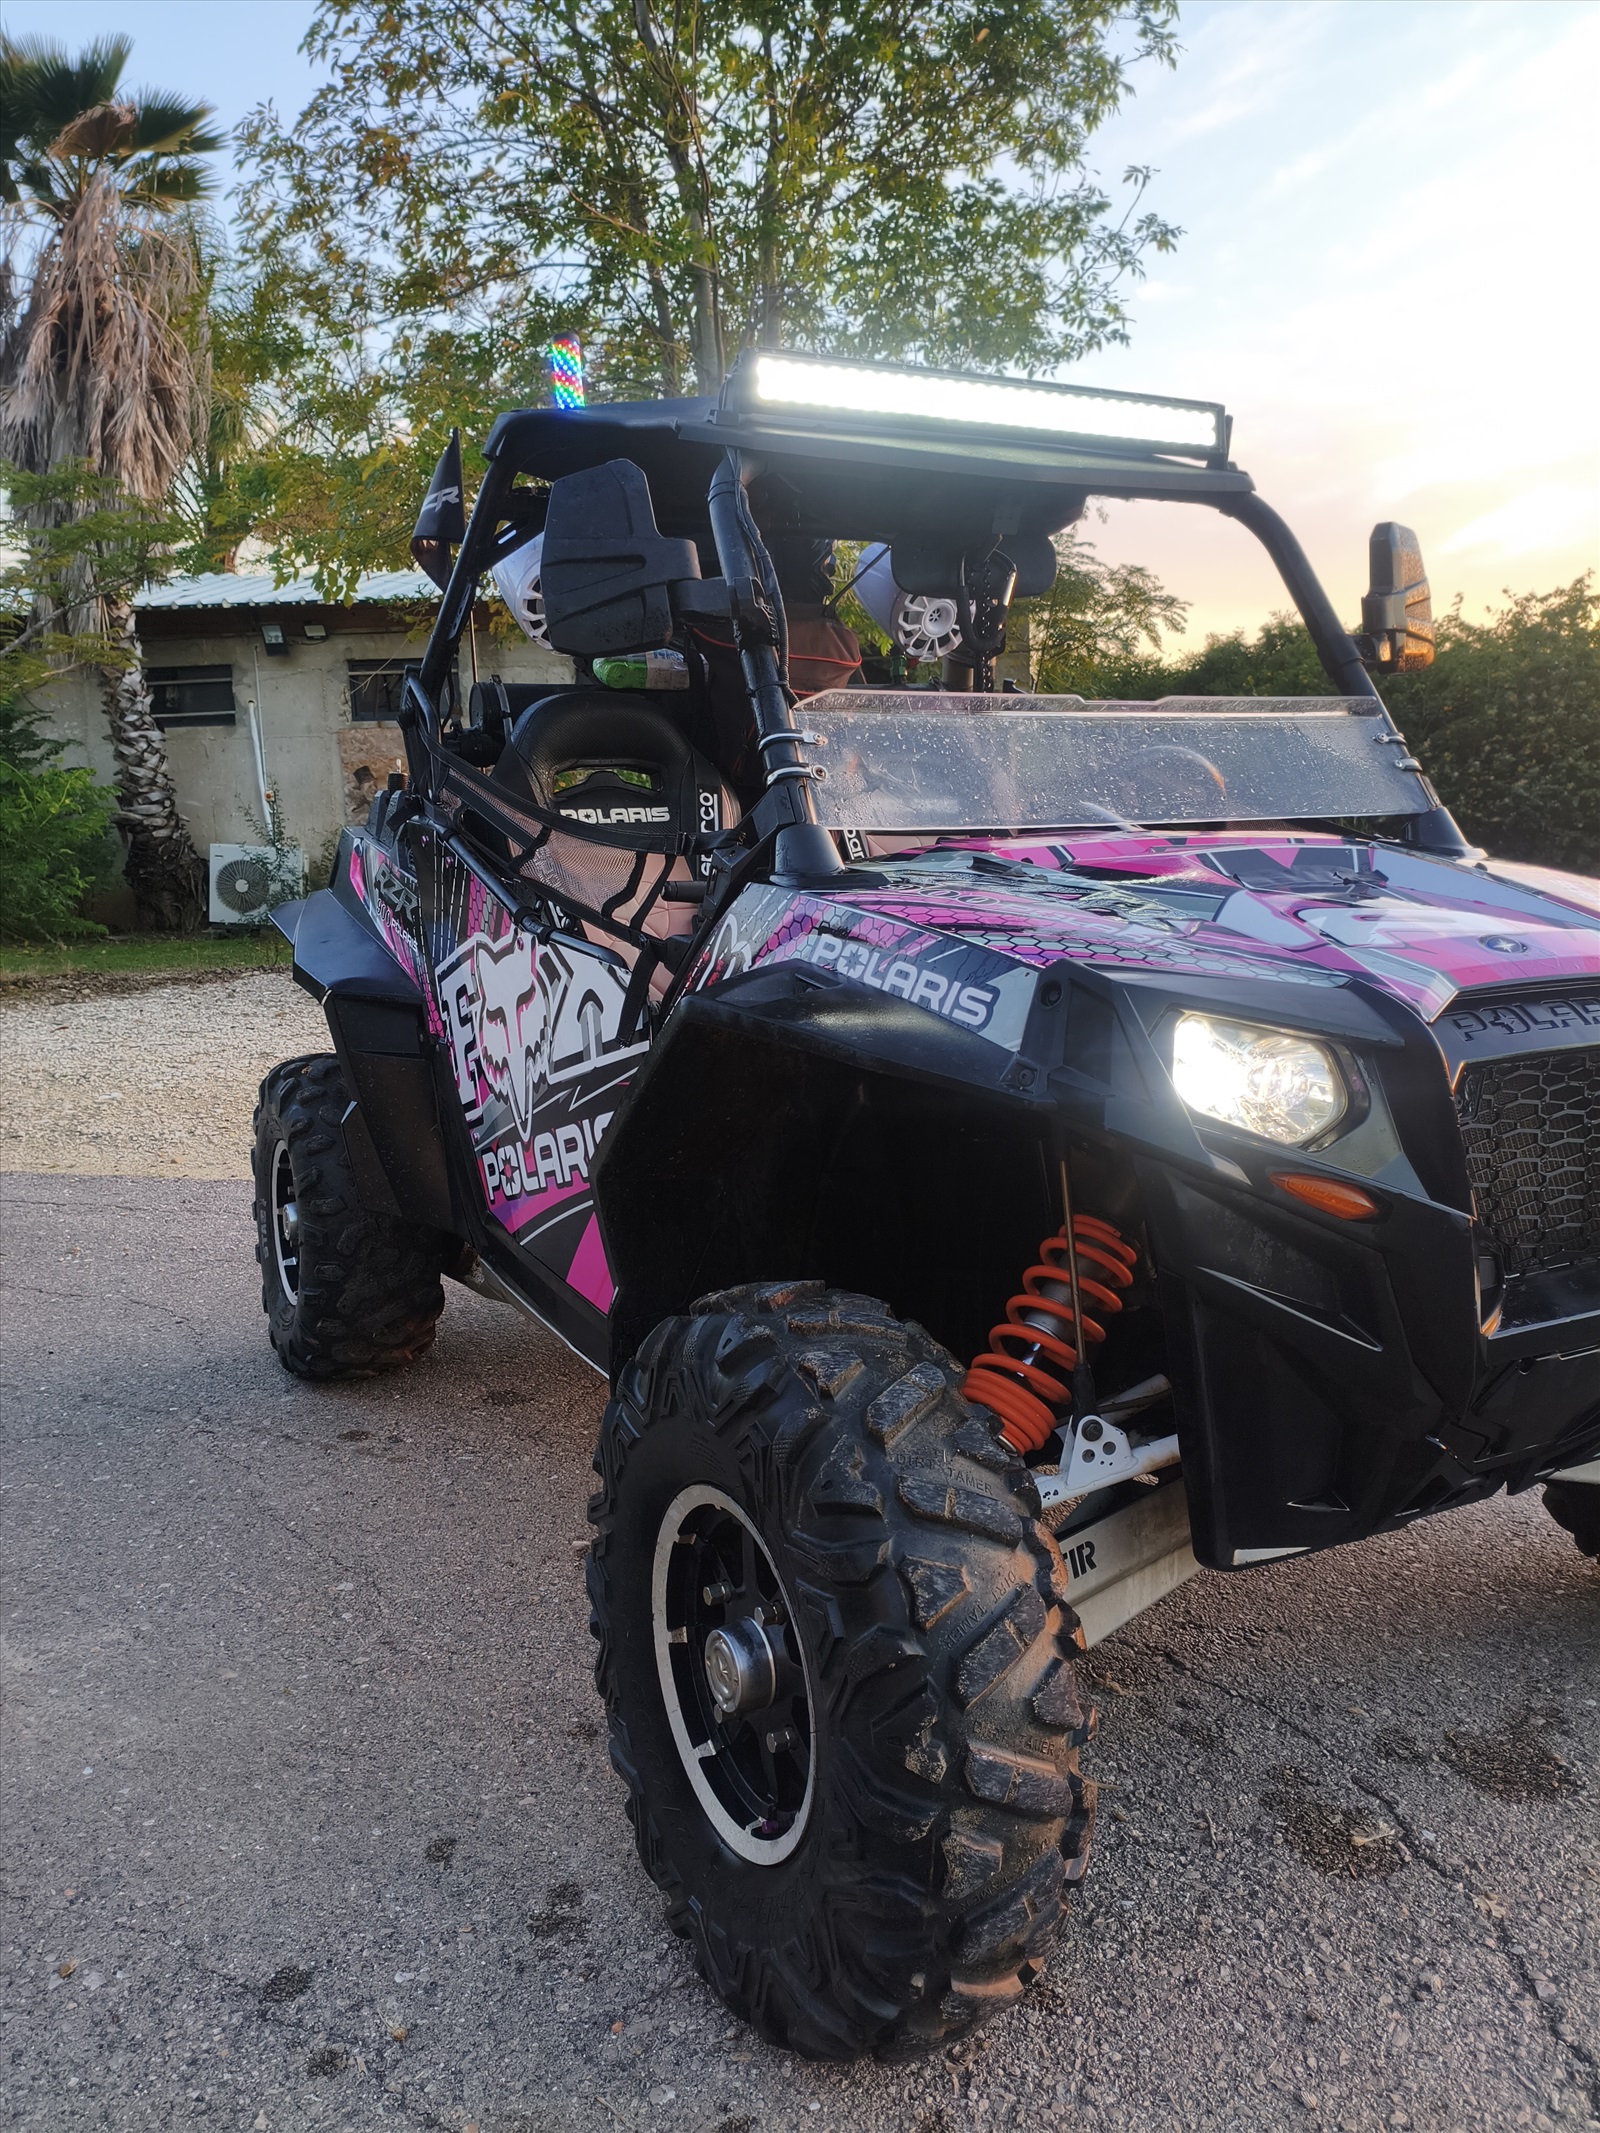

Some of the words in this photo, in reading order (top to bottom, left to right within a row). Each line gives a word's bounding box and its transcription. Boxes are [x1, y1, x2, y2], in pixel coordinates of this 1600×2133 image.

[422, 485, 460, 513] ZR
[559, 806, 671, 825] POLARIS
[391, 918, 418, 952] POLARIS
[812, 932, 993, 1027] POLARIS
[895, 1453, 937, 1471] DIRT
[948, 1466, 994, 1496] TAMER
[991, 1569, 1017, 1605] DIRT
[941, 1603, 988, 1651] TAMER
